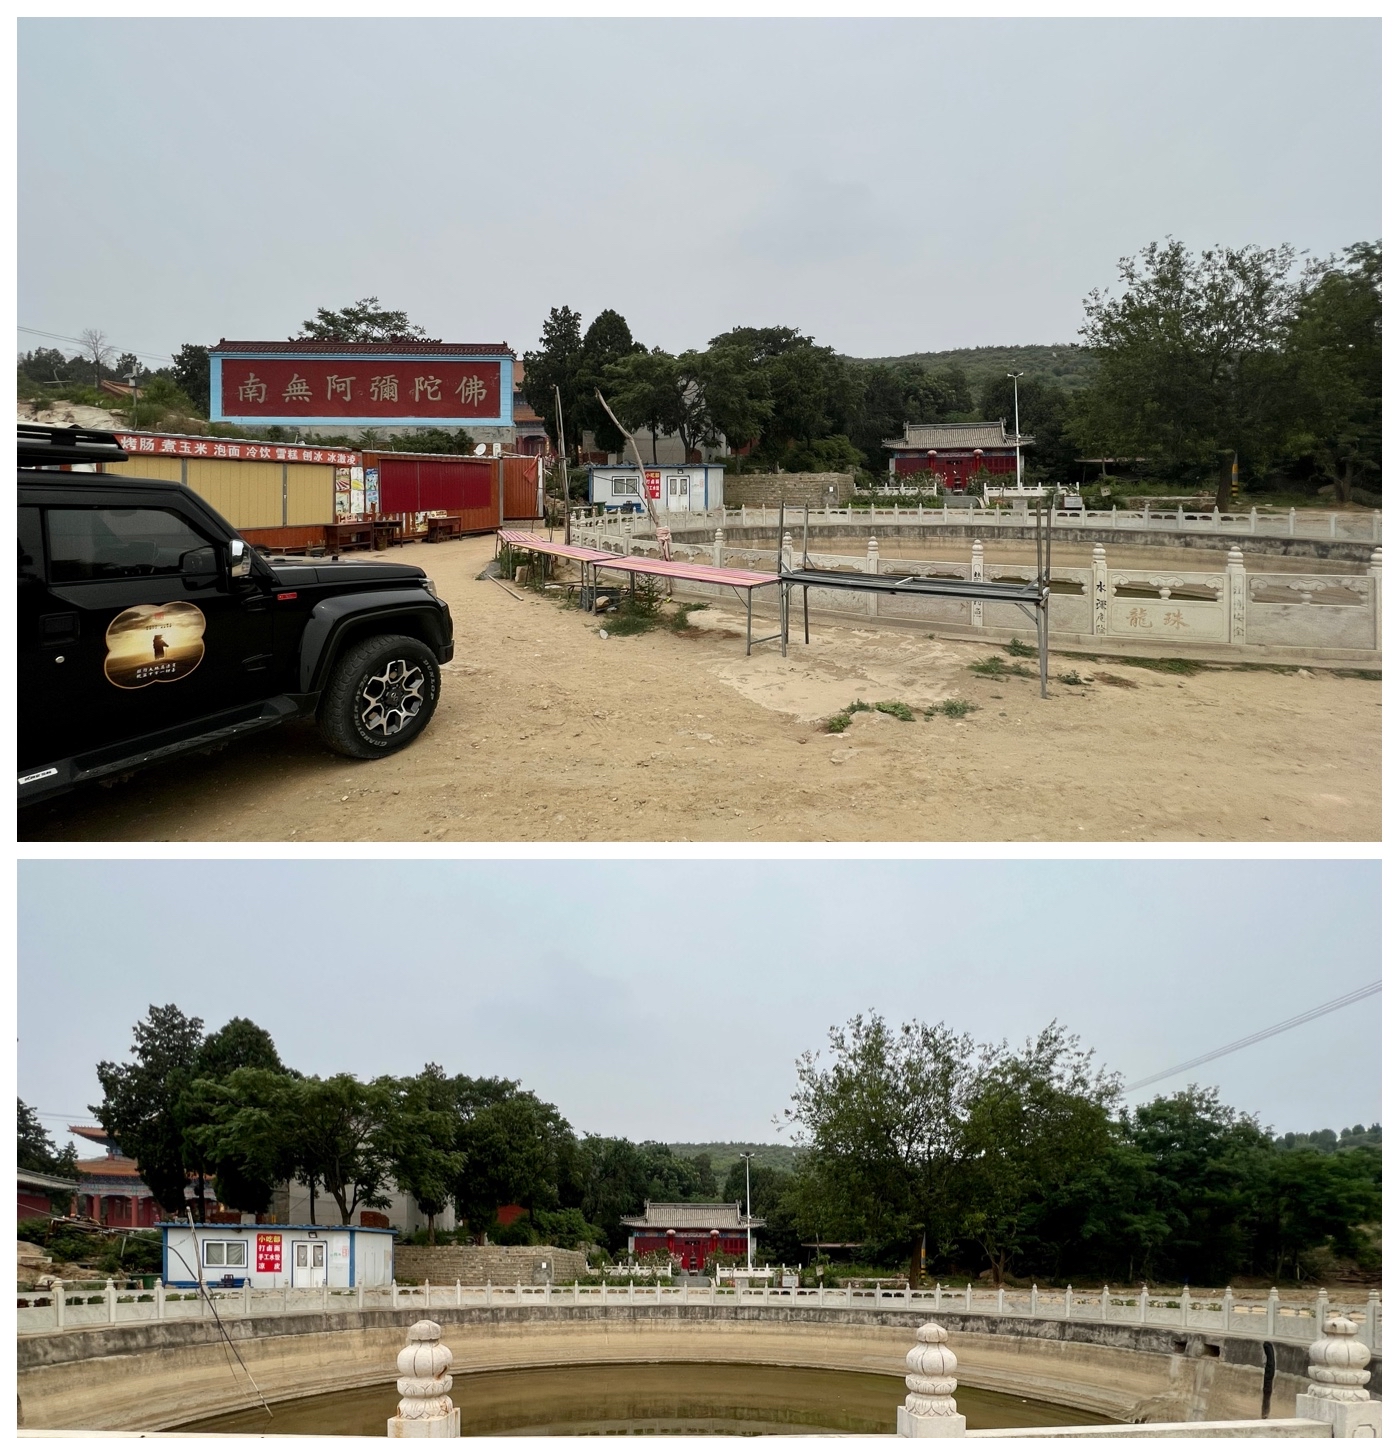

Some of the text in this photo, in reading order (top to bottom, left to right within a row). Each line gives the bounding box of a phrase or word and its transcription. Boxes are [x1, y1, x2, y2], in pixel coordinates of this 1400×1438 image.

[238, 372, 487, 407] 南無阿彌陀佛
[120, 436, 356, 465] 烤肠 煮玉米 泡面 冷饮 雪糕 刨冰 冰激凌
[1126, 608, 1190, 631] 龍珠
[422, 659, 437, 701] DUNLOP
